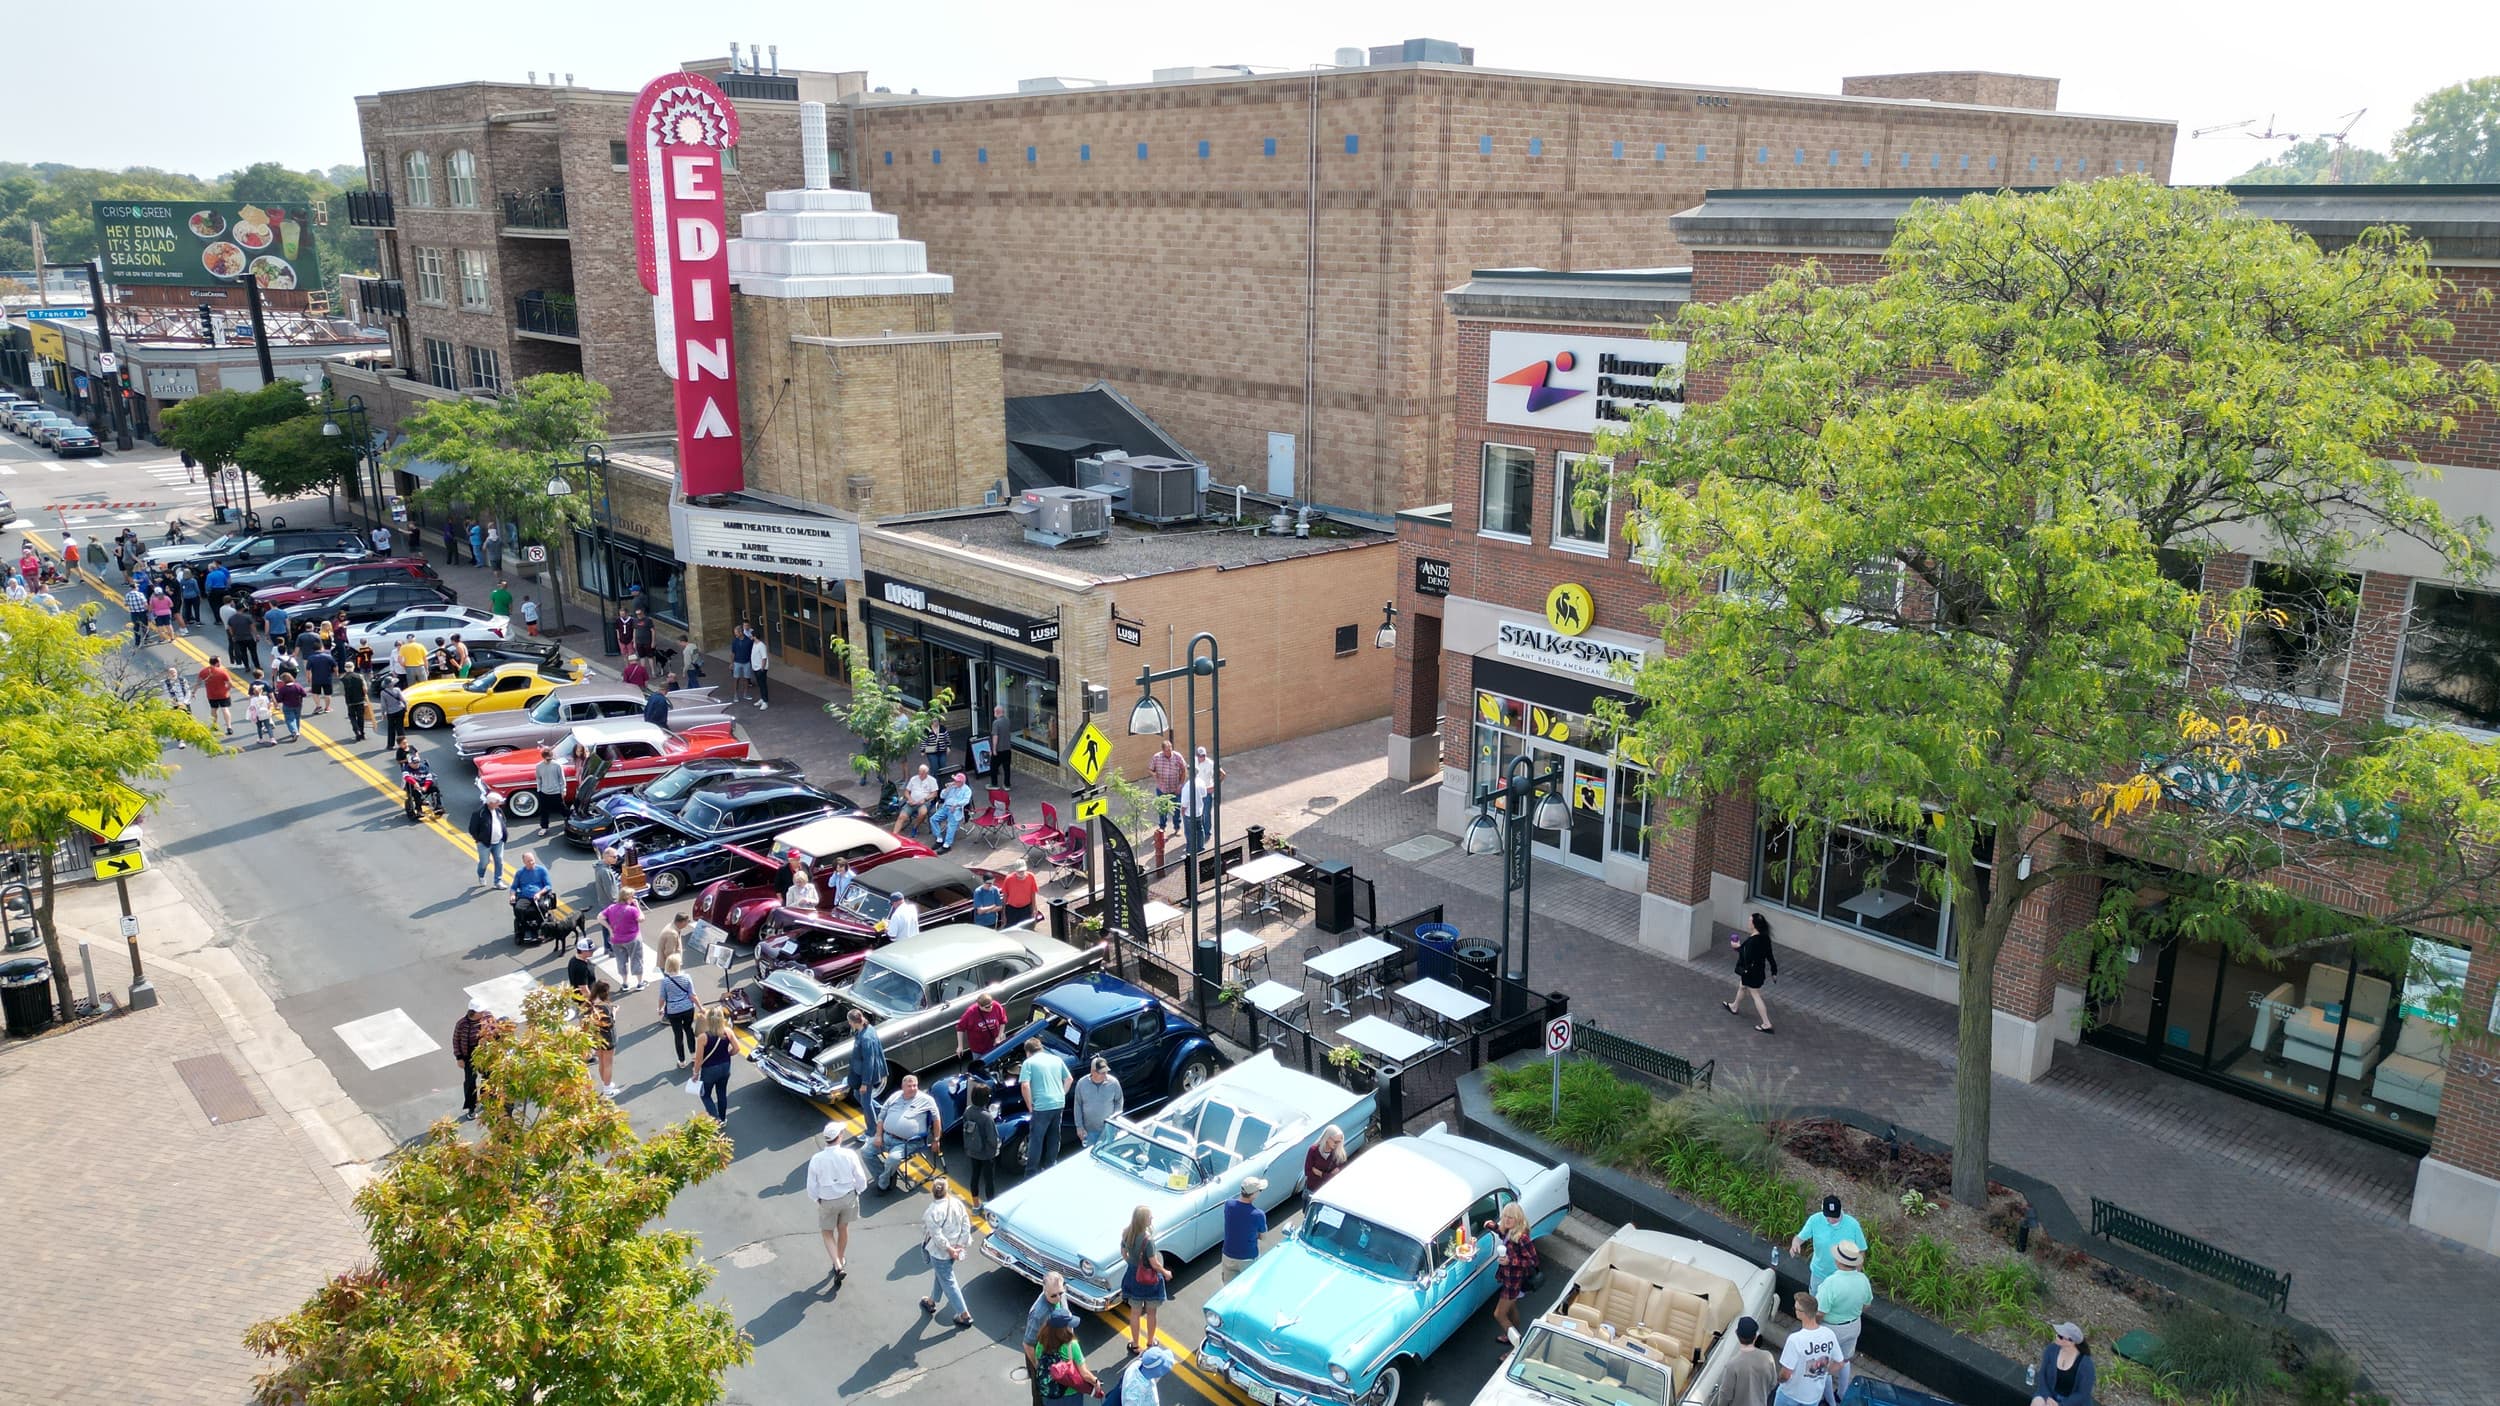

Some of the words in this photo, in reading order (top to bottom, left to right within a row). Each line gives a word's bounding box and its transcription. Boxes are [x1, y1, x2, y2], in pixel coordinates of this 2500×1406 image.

[105, 225, 130, 238] HEY
[134, 225, 178, 240] EDINA,
[108, 239, 131, 251] IT'S
[134, 240, 176, 252] SALAD
[110, 252, 166, 266] SEASON.
[671, 155, 733, 440] EDINA
[741, 542, 769, 552] BARBIE
[707, 549, 718, 557] MY
[722, 551, 733, 559] BIG
[736, 552, 748, 561] FAT
[752, 553, 775, 563] GREEK
[778, 556, 812, 567] WEDDING
[884, 582, 926, 611] LUSH
[927, 602, 947, 616] FRESH
[947, 608, 982, 627] HANDMADE
[982, 619, 1020, 638] COSMETICS
[1030, 626, 1058, 640] LUSH
[1117, 627, 1139, 642] LUSH
[1499, 624, 1561, 655] STALK
[1573, 640, 1641, 672] SPADE
[1512, 650, 1534, 660] PLANT
[1537, 655, 1561, 666] BASED
[1563, 661, 1601, 675] AMERICAN
[1120, 904, 1129, 929] FREE
[1804, 1341, 1834, 1356] Jeep
